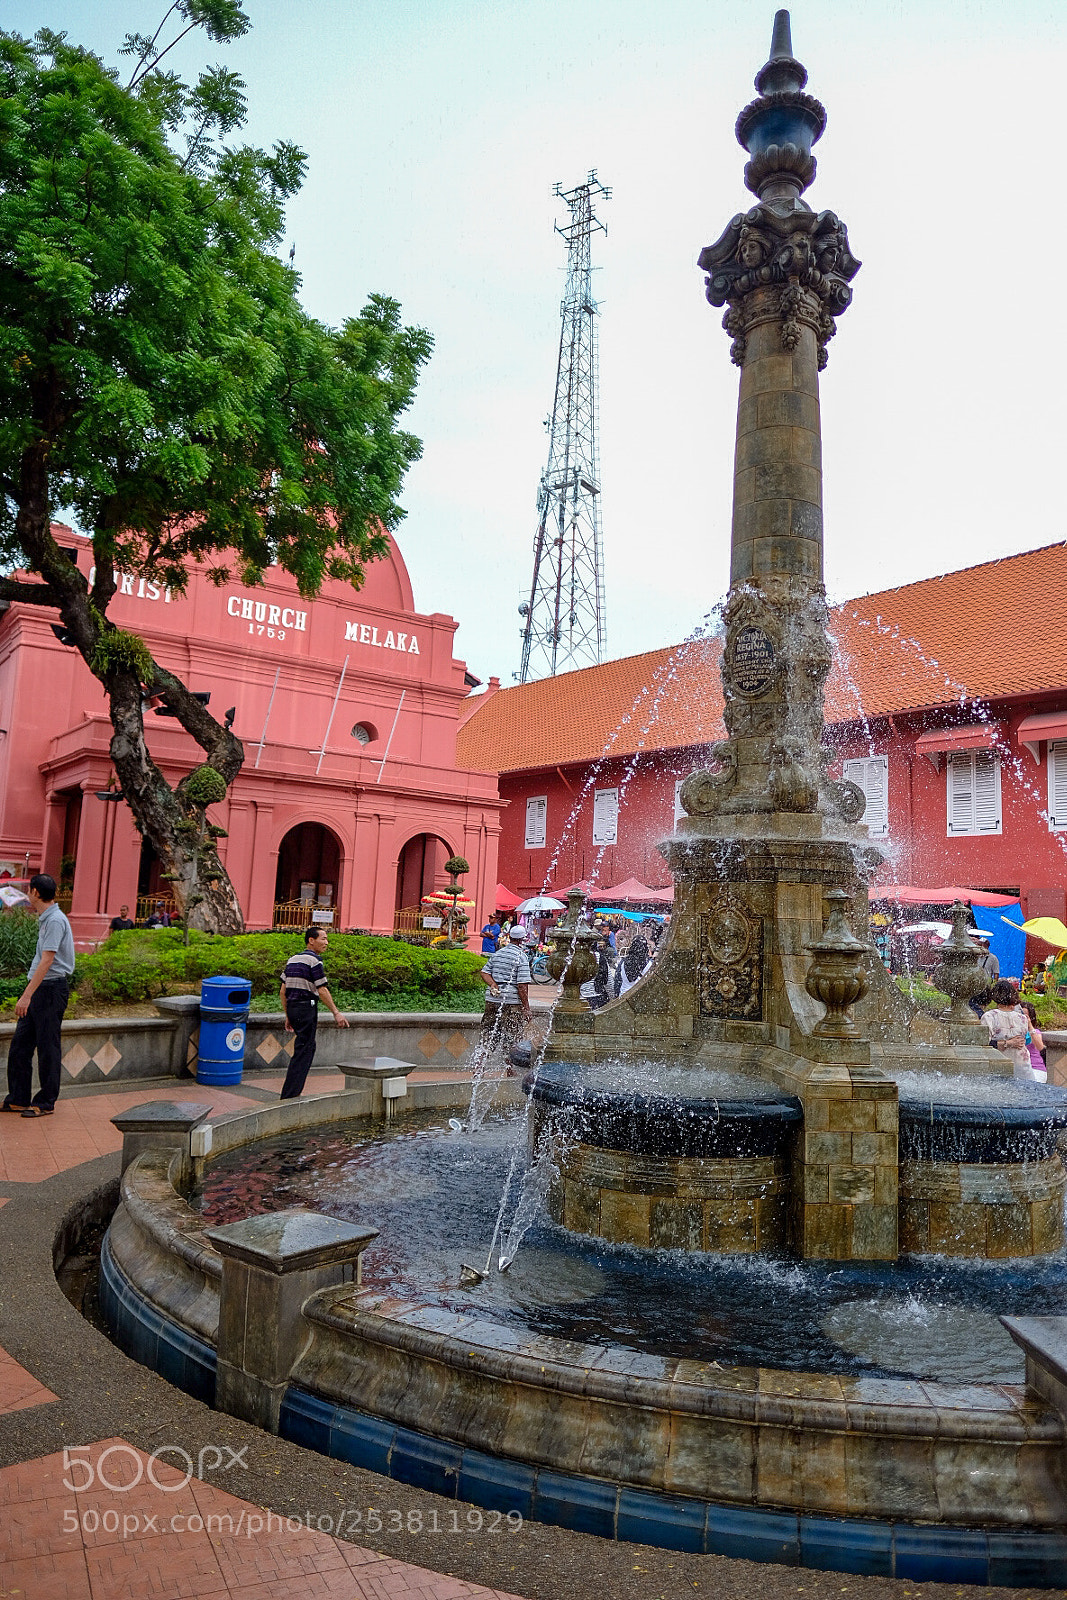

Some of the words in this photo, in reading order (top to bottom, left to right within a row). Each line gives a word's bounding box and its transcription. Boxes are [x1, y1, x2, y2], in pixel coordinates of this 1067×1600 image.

[227, 595, 308, 631] CHURCH
[344, 621, 421, 655] MELAKA
[248, 622, 286, 641] 1753
